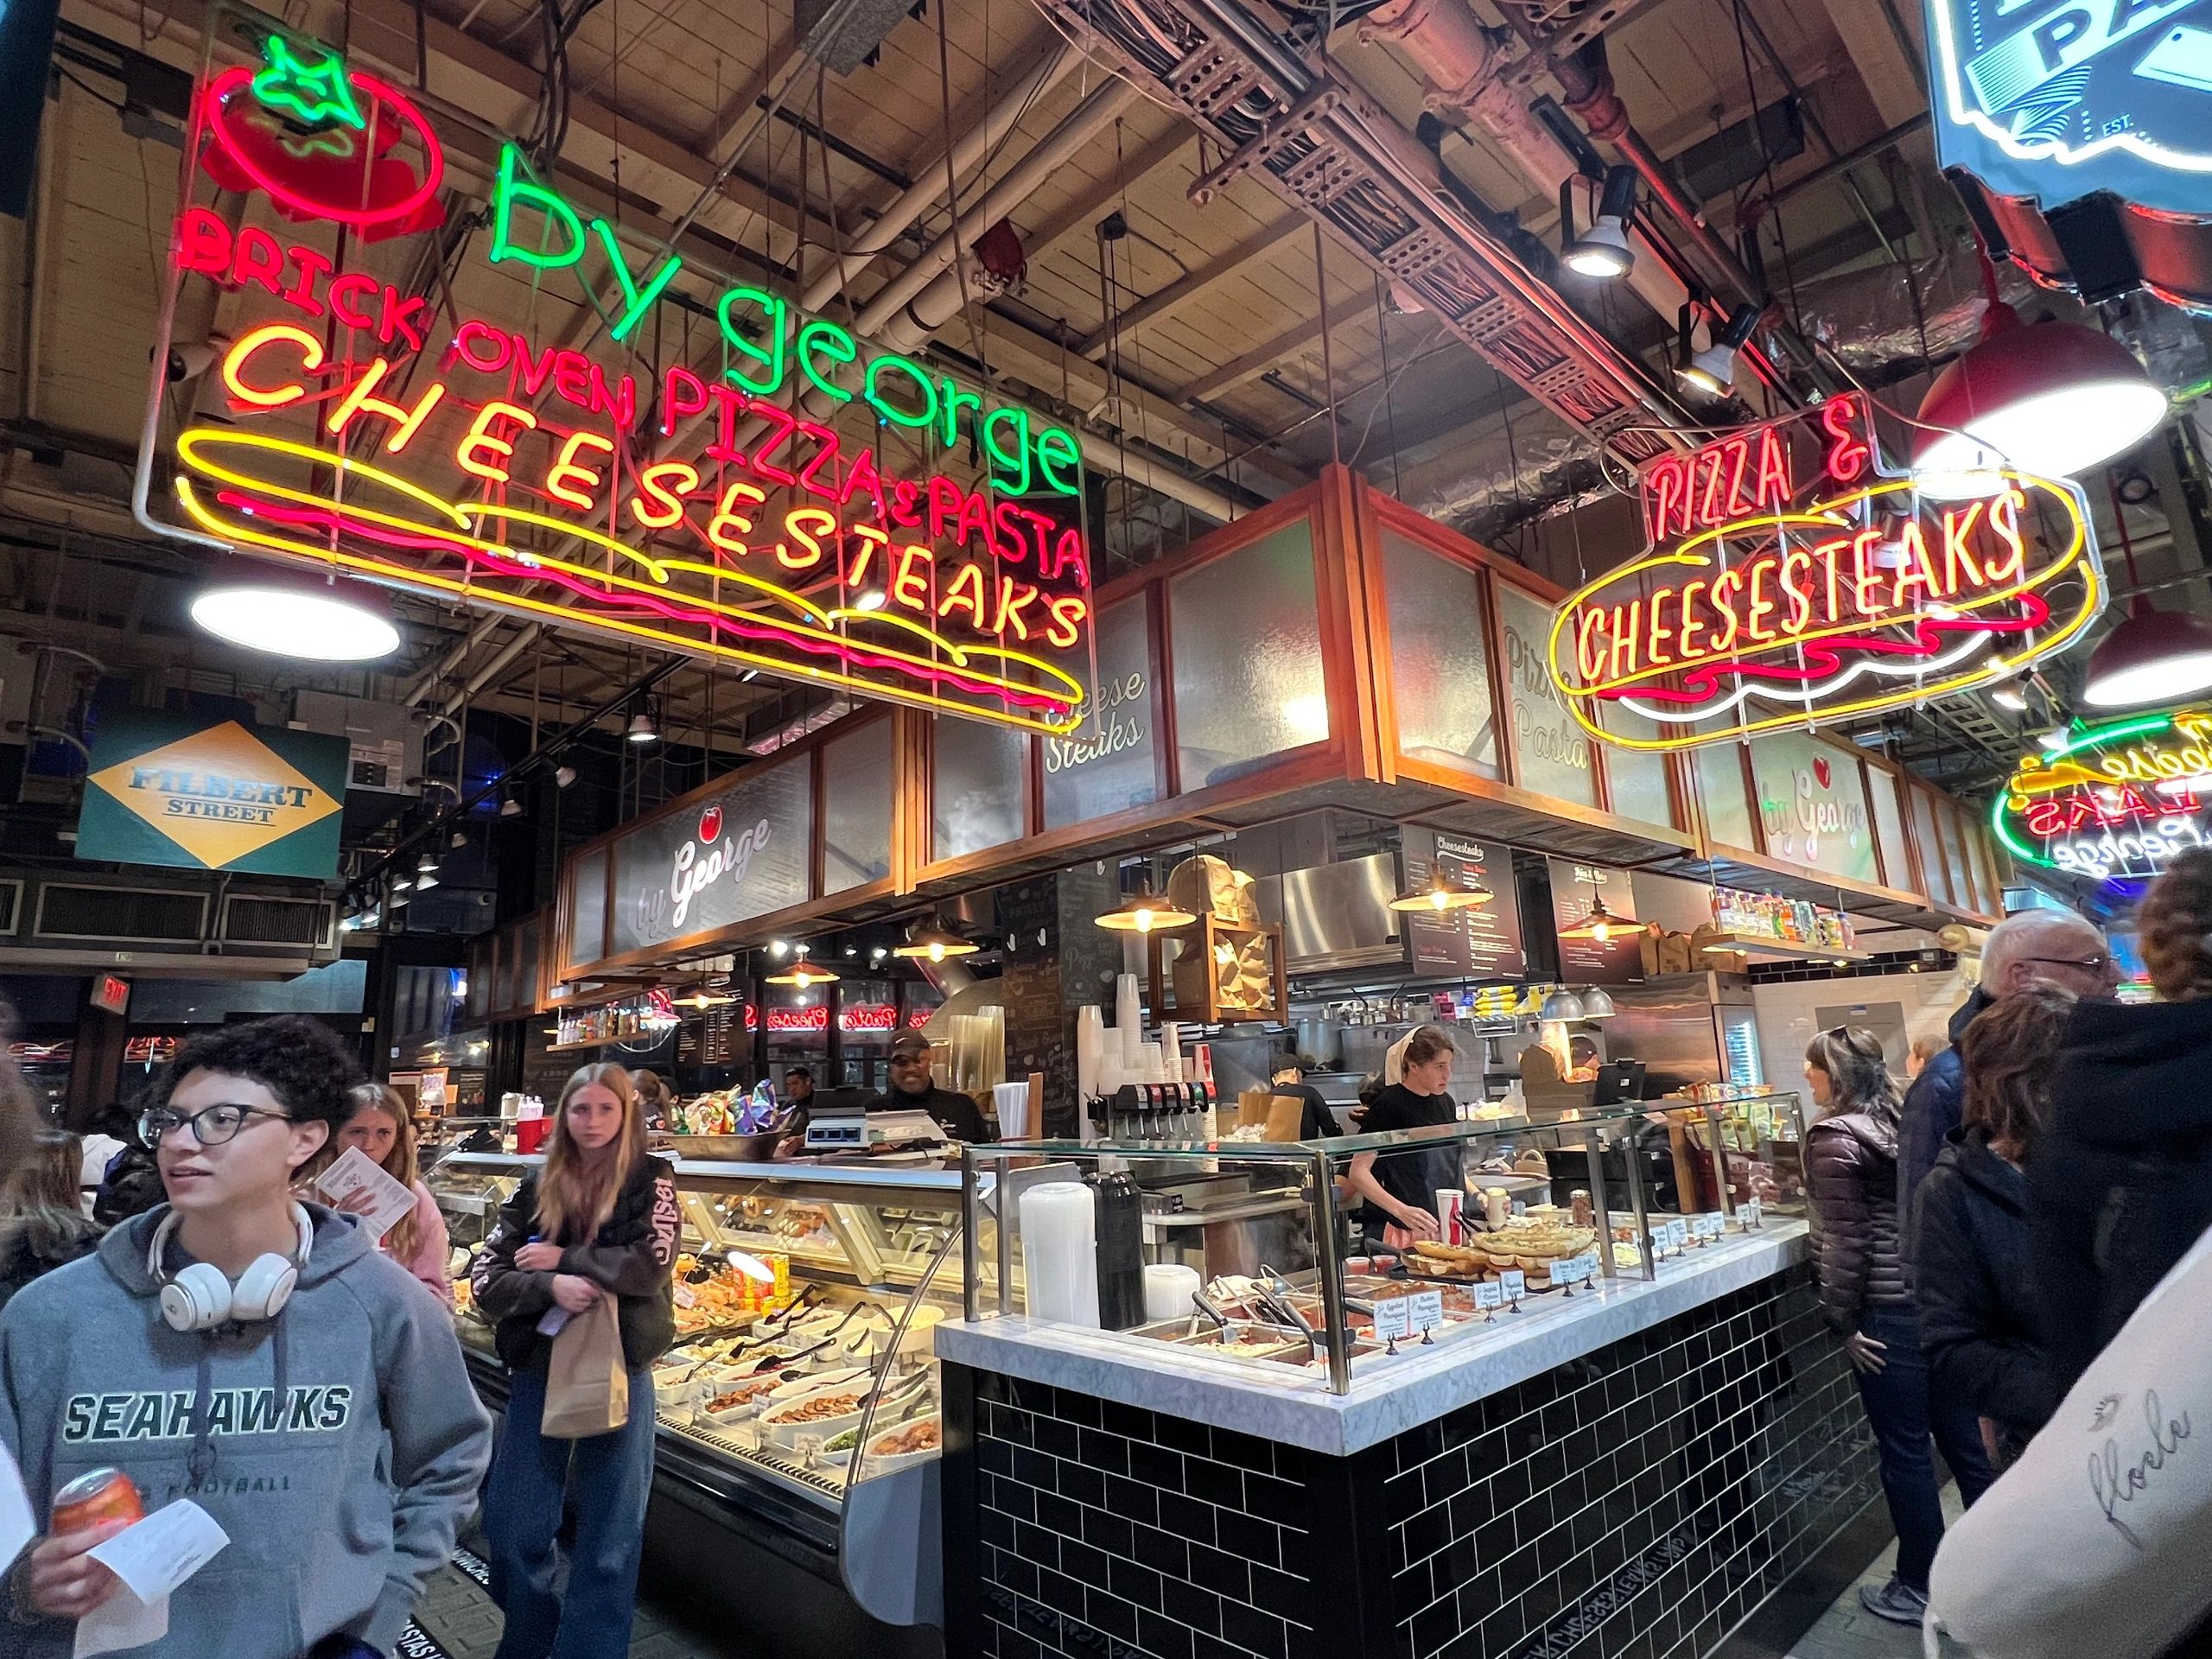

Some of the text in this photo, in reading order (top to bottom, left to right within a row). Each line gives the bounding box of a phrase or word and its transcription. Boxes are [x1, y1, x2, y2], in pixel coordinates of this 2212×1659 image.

[2101, 114, 2134, 137] EST.
[489, 142, 1080, 497] by george
[177, 208, 1090, 589] BRICK OVEN PIZZA & PASTA
[221, 324, 1088, 648] CHEESESTEAKS
[1648, 399, 1868, 543] PIZZA &
[1577, 487, 2026, 681] CHEESESTEAKS
[1046, 711, 1145, 774] Steaks
[1513, 696, 1589, 771] Pasta
[128, 766, 313, 809] FILBERT
[167, 798, 274, 823] STREET
[1791, 768, 1866, 861] George
[636, 816, 772, 939] by George
[63, 1384, 353, 1442] SEAHAWKS
[168, 1474, 291, 1502] FOOTBALL
